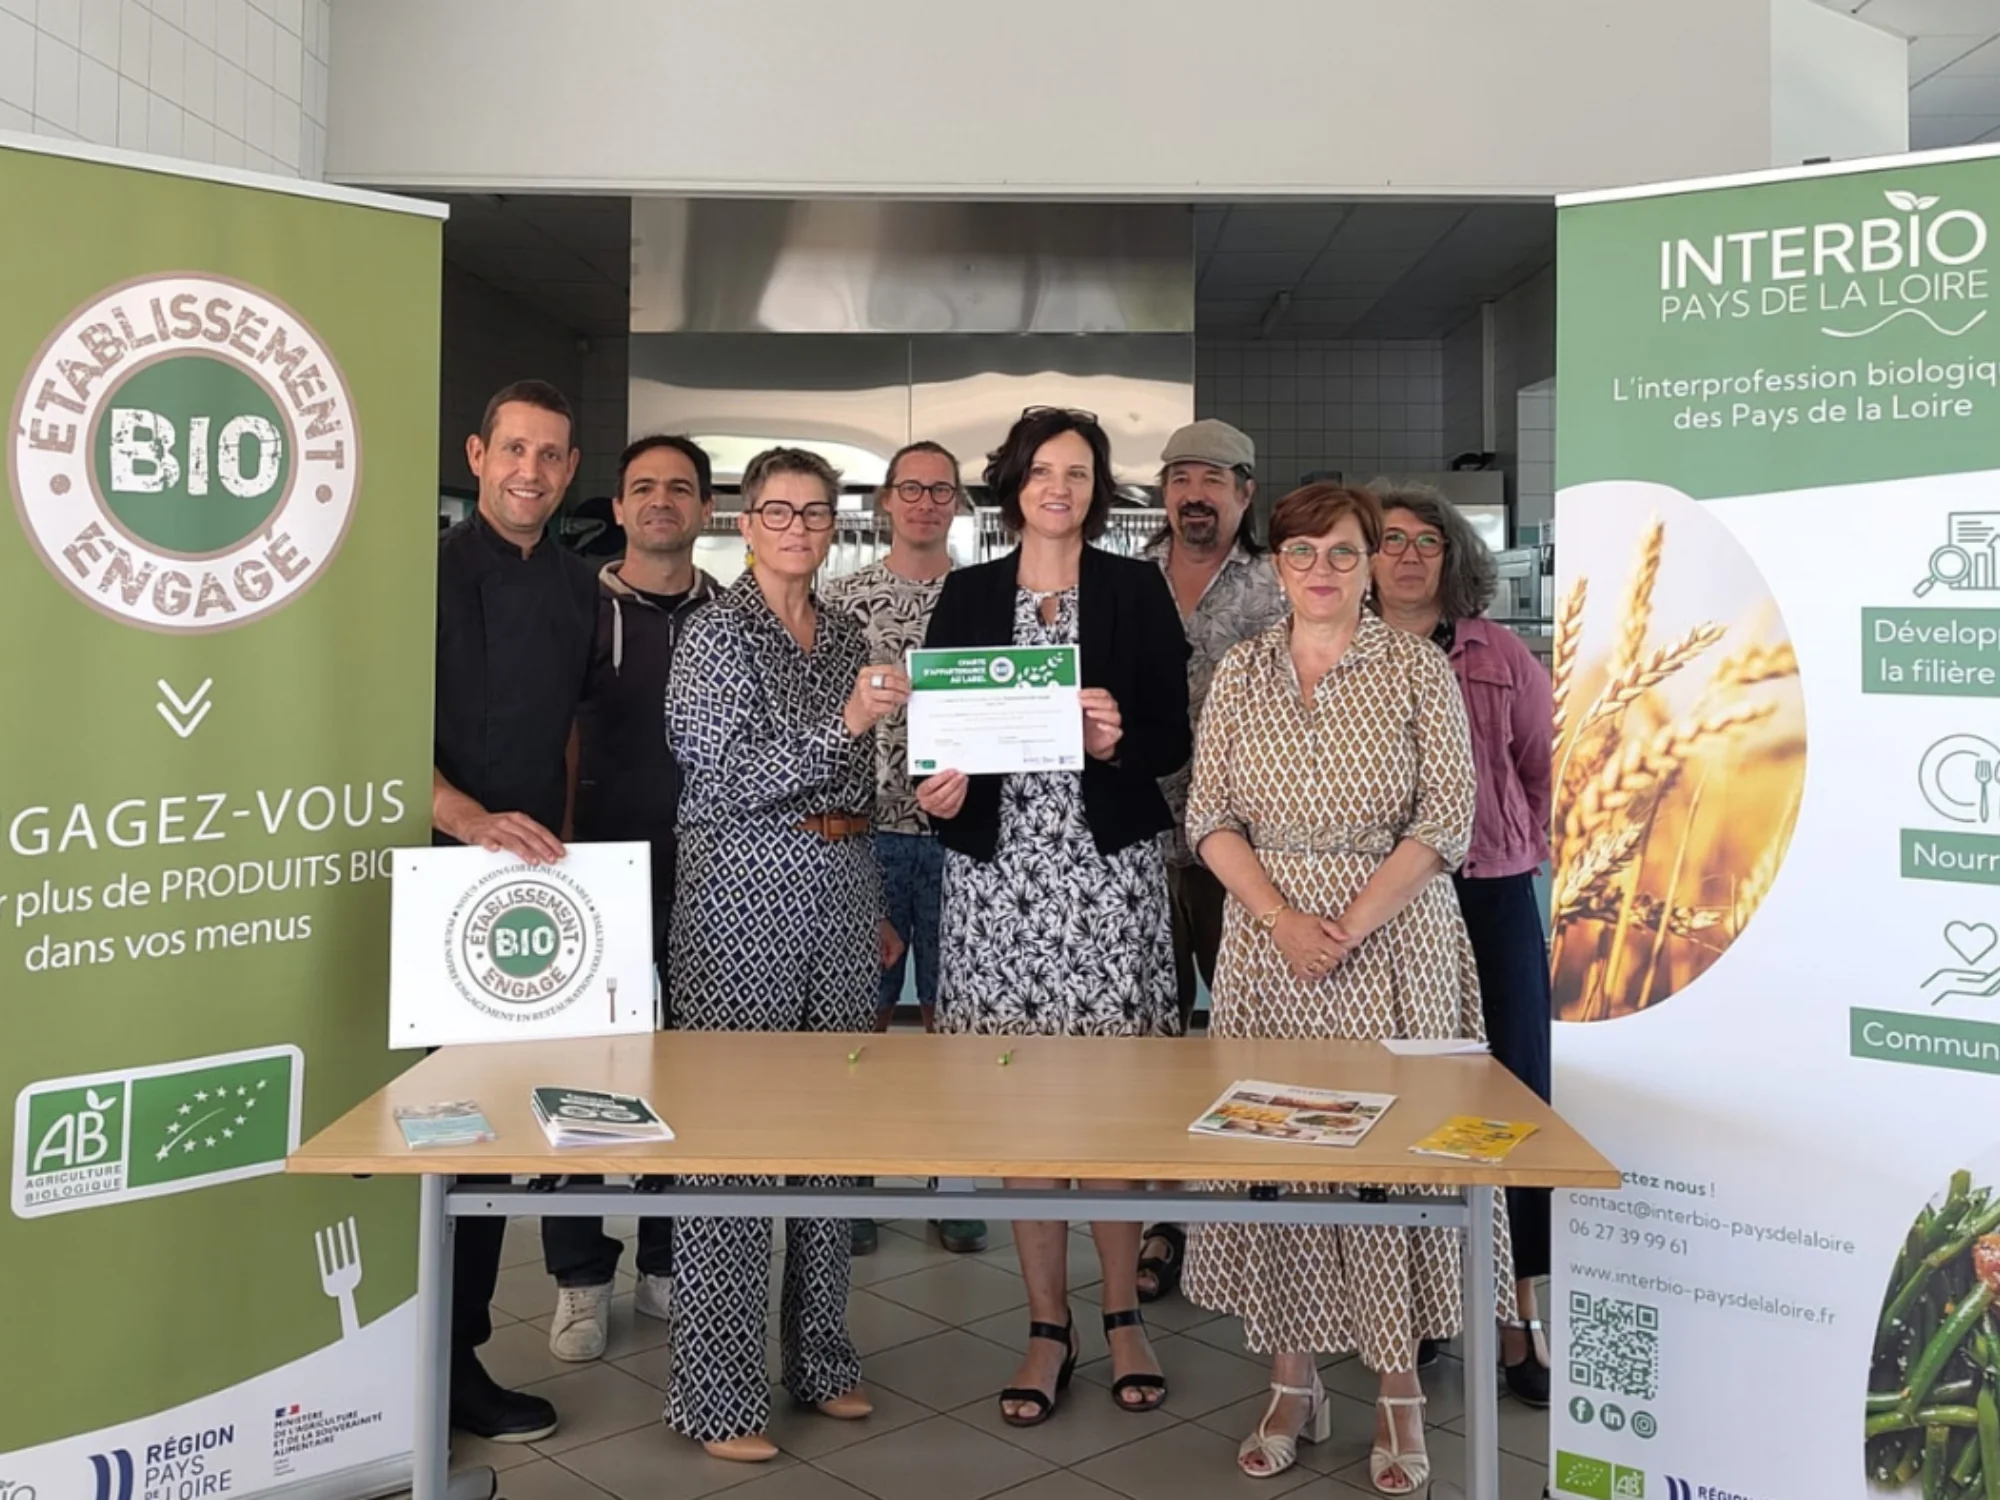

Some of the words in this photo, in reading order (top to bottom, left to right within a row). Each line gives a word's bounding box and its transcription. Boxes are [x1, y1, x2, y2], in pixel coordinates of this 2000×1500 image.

[1661, 209, 1988, 290] INTERBIO
[1661, 290, 1750, 322] PAYS
[1762, 285, 1807, 315] DE
[1820, 280, 1867, 310] LA
[1879, 269, 1989, 305] LOIRE
[1613, 366, 1857, 402] L'interprofession
[1868, 355, 2000, 389] biologiq
[1674, 406, 1722, 430] des
[1732, 402, 1799, 432] Pays
[1808, 399, 1846, 424] de
[1857, 396, 1881, 420] la
[1892, 392, 1972, 419] Loire
[109, 408, 282, 498] BIO
[1875, 619, 2000, 651] Dévelop
[1881, 658, 1903, 682] la
[1911, 658, 1996, 684] filière
[9, 779, 405, 856] GAGEZ-VOUS
[16, 880, 93, 927] plus
[102, 873, 150, 908] de
[162, 853, 340, 902] PRODUITS
[25, 935, 114, 971] dans
[125, 929, 185, 958] vos
[196, 914, 311, 951] menus
[495, 925, 556, 957] BIO
[33, 1111, 108, 1171] AB
[25, 1178, 121, 1203] BIOLOGIQUE
[26, 1164, 121, 1189] AGRICULTURE
[1664, 1179, 1706, 1196] nous
[1569, 1192, 1855, 1254] contact@interbio-paysdelaloire
[1569, 1218, 1590, 1236] 06
[1595, 1223, 1614, 1241] 27
[1620, 1227, 1640, 1245] 39
[1644, 1232, 1666, 1250] 99
[1670, 1239, 1688, 1256] 61
[1569, 1262, 1836, 1325] www.interbio-paysdelaloire.fr
[146, 1425, 234, 1464] RÉGION
[145, 1454, 205, 1488] PAYS
